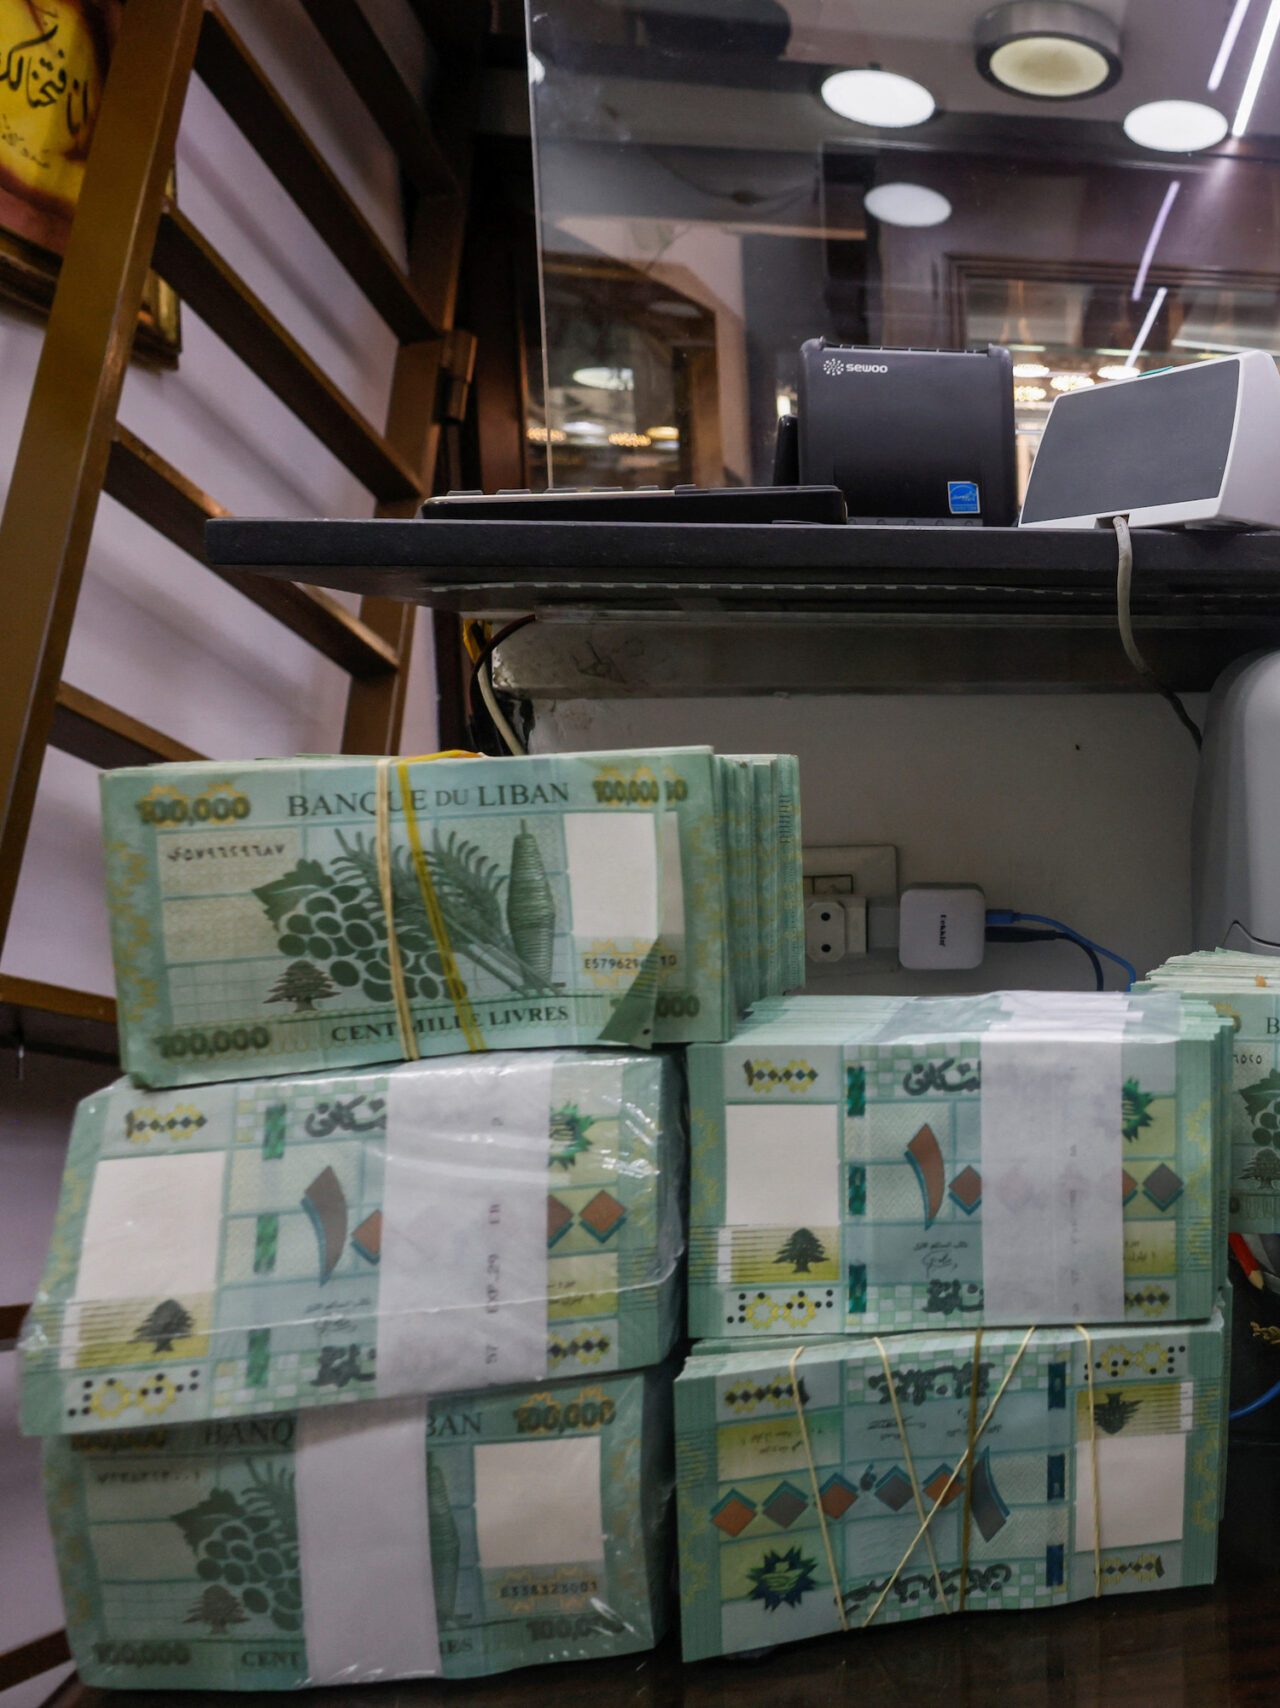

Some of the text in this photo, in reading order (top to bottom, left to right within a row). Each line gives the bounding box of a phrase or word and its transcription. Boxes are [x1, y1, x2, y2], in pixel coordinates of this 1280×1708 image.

[846, 363, 888, 373] sewoo
[136, 795, 252, 827] 100,000
[435, 789, 470, 807] DU
[478, 782, 570, 808] LIBAN
[331, 1021, 396, 1043] CENT
[489, 1005, 569, 1027] LIVRES
[513, 1400, 617, 1434] 100,000
